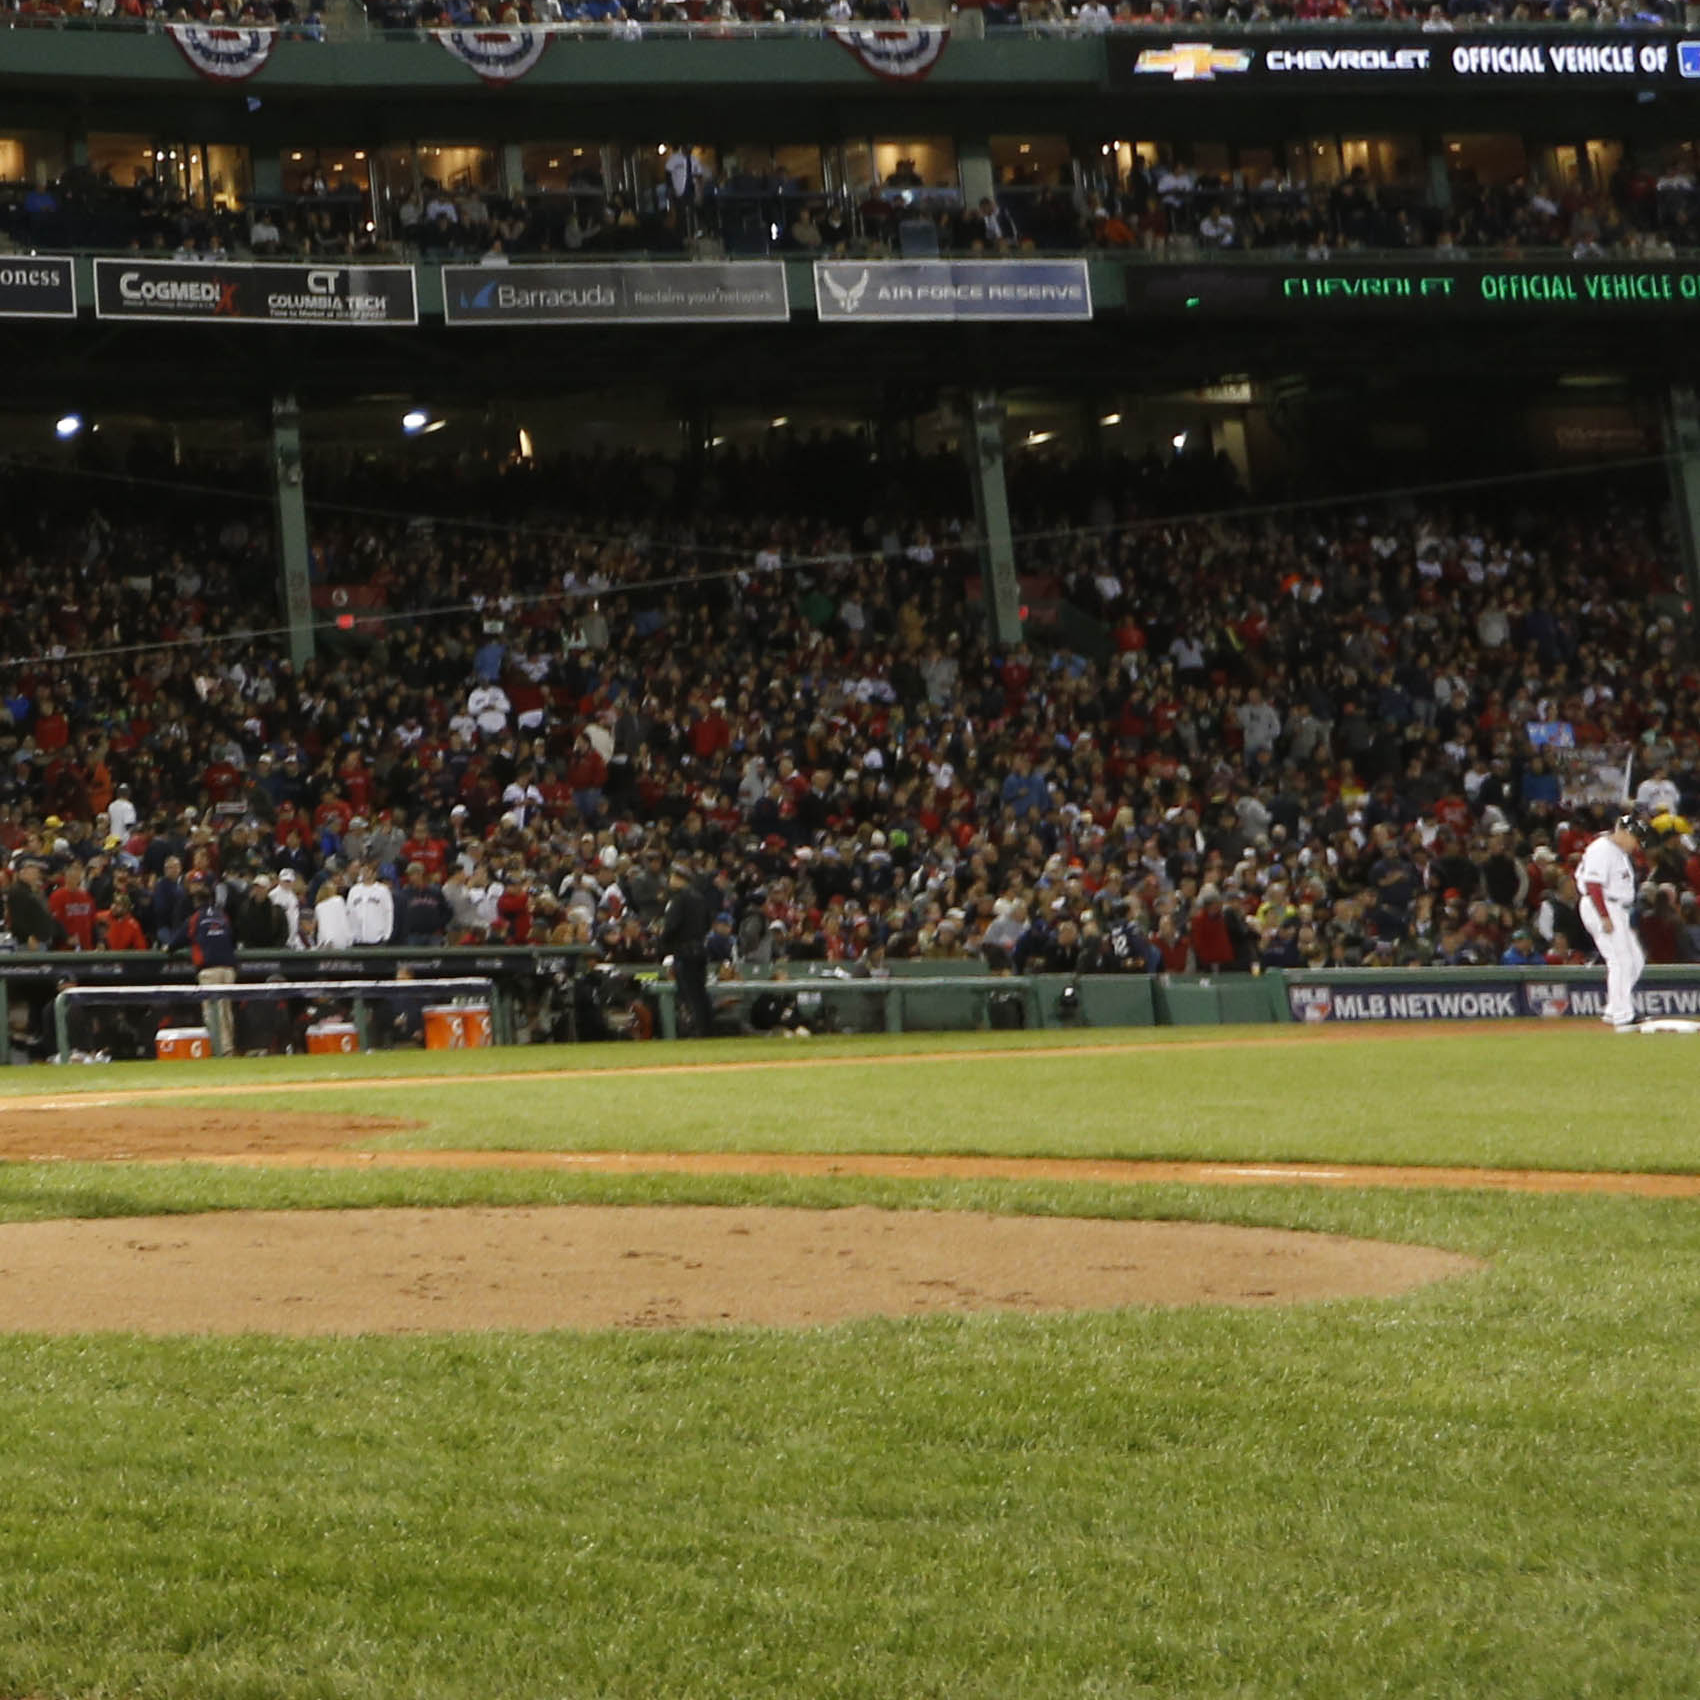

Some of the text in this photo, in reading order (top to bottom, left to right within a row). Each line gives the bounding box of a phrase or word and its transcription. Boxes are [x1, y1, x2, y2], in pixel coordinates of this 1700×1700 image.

[1266, 45, 1668, 73] CHEVROLET OFFICIAL VEHICLE OF
[498, 284, 616, 309] Barracuda
[878, 284, 1082, 300] AIR FORCE RESERVE
[1481, 274, 1577, 300] OFFICIAL
[1584, 274, 1672, 300] VEHICLE
[268, 293, 387, 311] COLUMBIA TECH
[1334, 991, 1515, 1019] MLB NETWORK
[1571, 990, 1700, 1016] ML NETW
